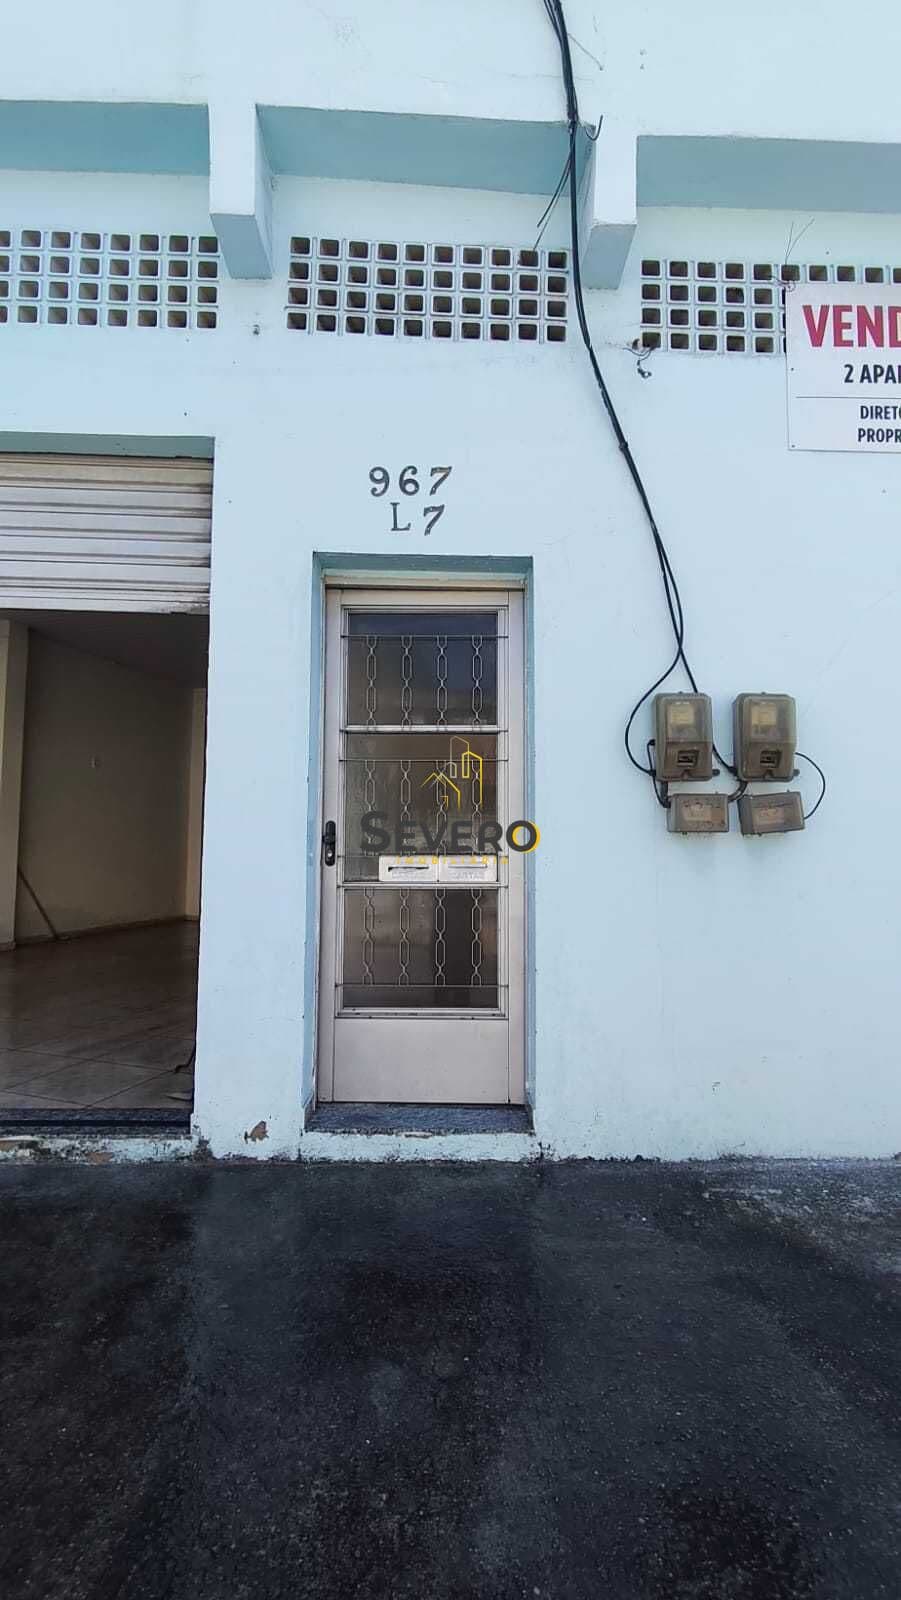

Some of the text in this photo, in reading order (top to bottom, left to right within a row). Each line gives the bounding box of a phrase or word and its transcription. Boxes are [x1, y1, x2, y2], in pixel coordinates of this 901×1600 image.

[844, 364, 901, 384] 2 APA
[860, 405, 901, 420] DIRET
[369, 465, 452, 497] 967
